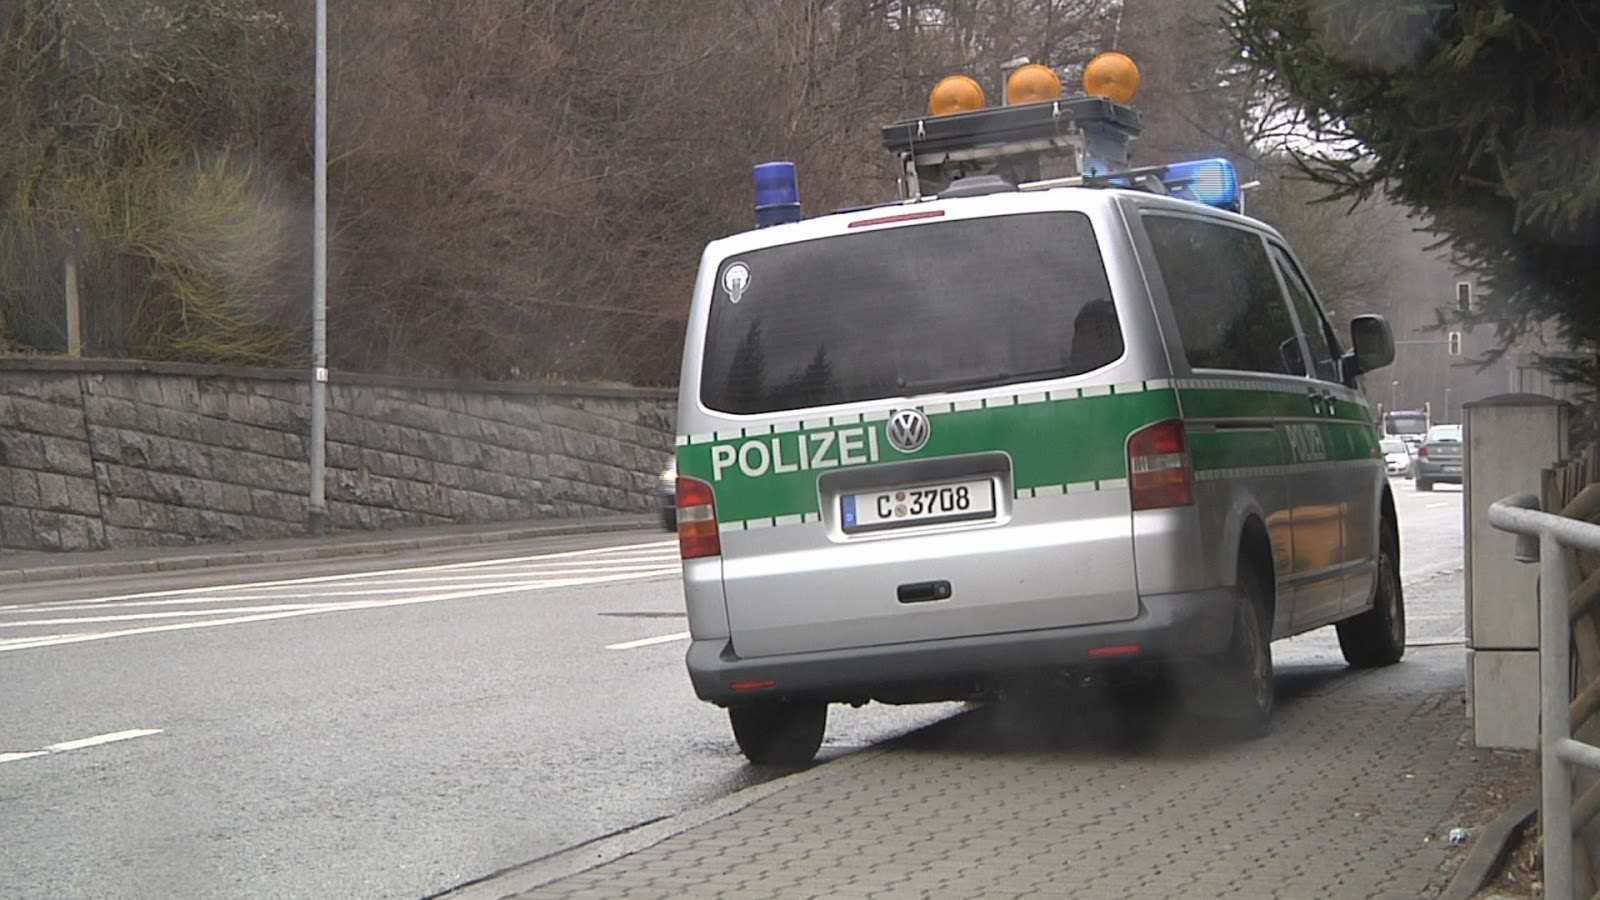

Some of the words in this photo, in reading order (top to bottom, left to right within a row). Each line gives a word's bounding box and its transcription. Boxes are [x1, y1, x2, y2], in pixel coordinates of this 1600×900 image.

[890, 411, 928, 450] VW
[711, 426, 879, 481] POLIZEI
[877, 495, 892, 519] C
[910, 486, 970, 515] 3708
